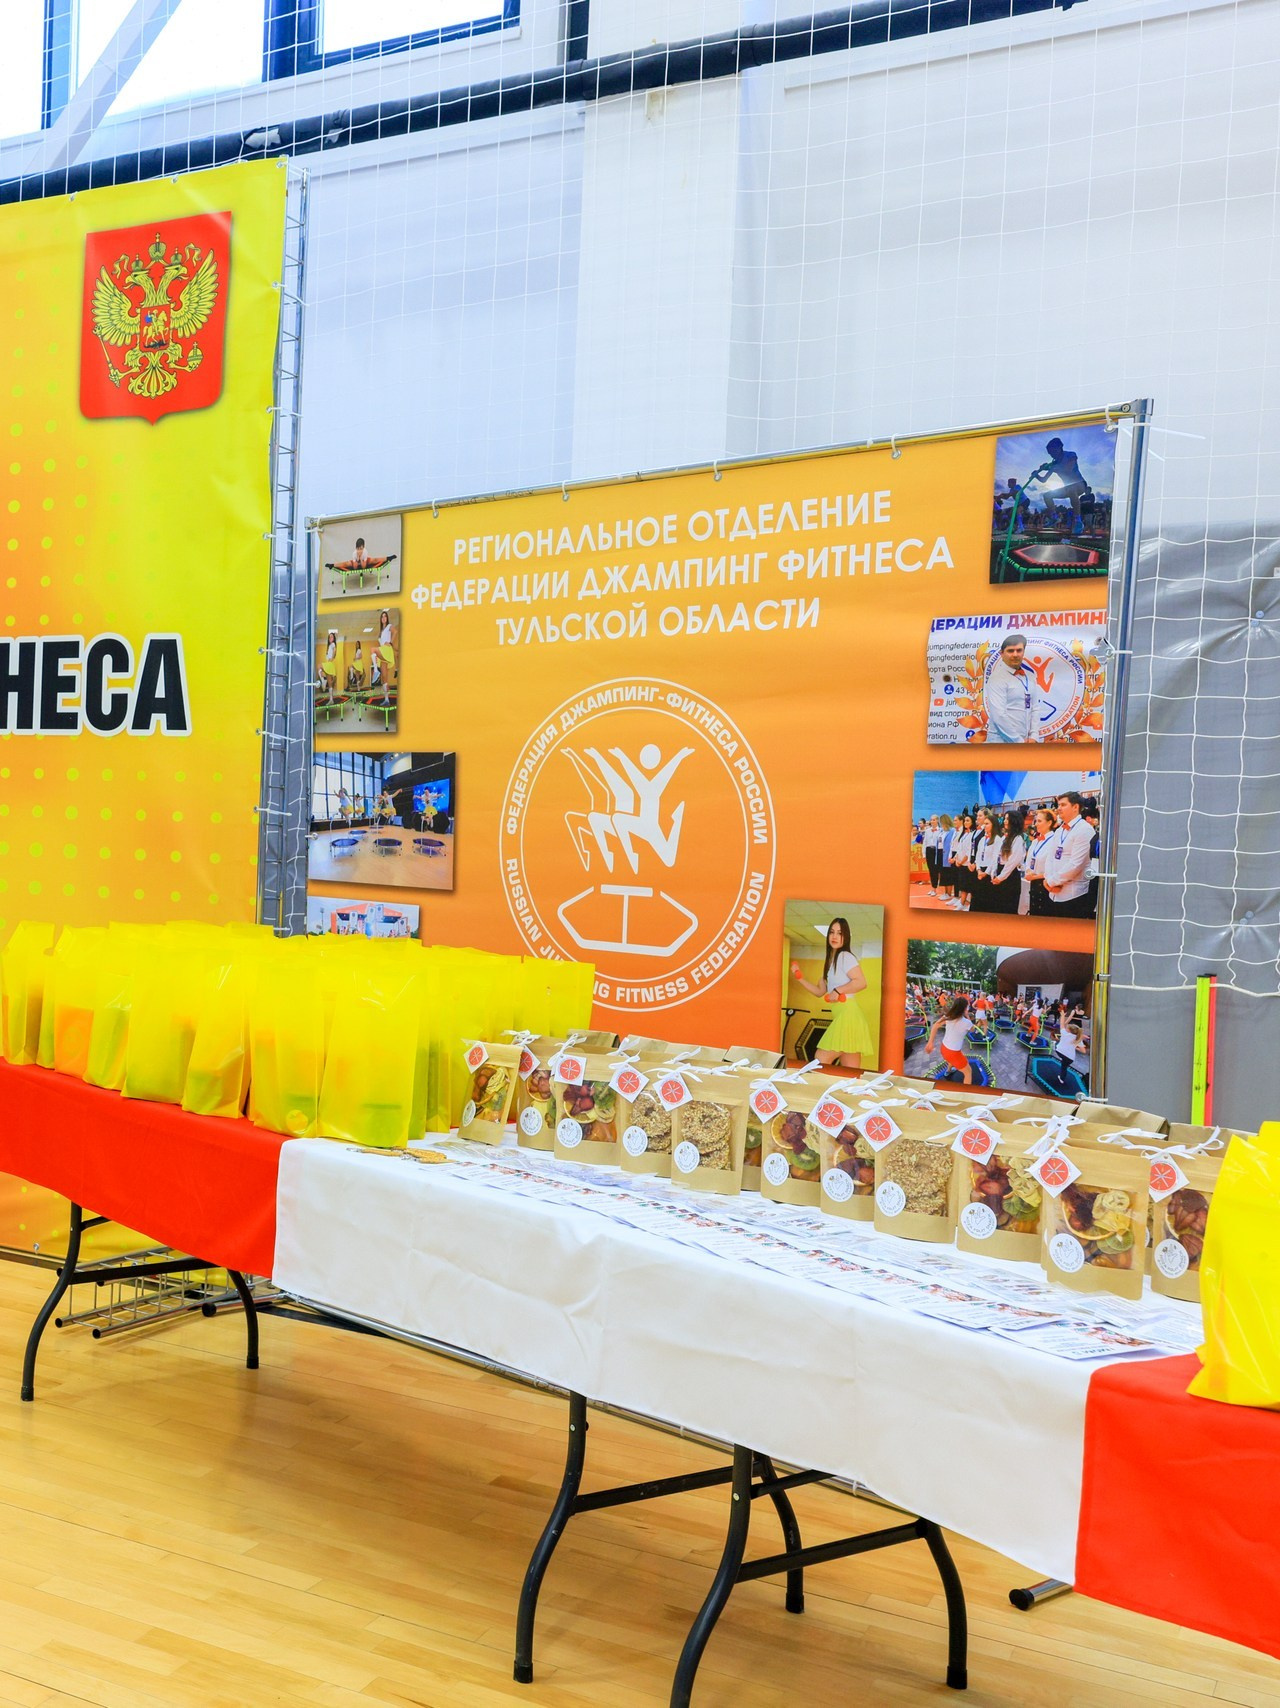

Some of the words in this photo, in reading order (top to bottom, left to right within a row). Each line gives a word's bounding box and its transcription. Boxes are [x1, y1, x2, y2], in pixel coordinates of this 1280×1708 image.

[453, 513, 677, 566] РЕГИОНАЛЬНОЕ
[688, 490, 891, 541] ОТДЕЛЕНИЕ
[411, 570, 569, 612] ФЕДЕРАЦИИ
[577, 552, 767, 599] ДЖАМПИНГ
[777, 537, 955, 582] ФИТНЕСА
[496, 602, 647, 645] ТУЛЬСКОЙ
[658, 598, 820, 635] ОБЛАСТИ
[506, 724, 558, 835] ФЕДЕРАЦИЯ
[733, 755, 768, 844] РОССИИ
[506, 858, 542, 942] RUSSIAN
[615, 977, 689, 1003] FITNESS
[690, 871, 766, 984] FEDERATION
